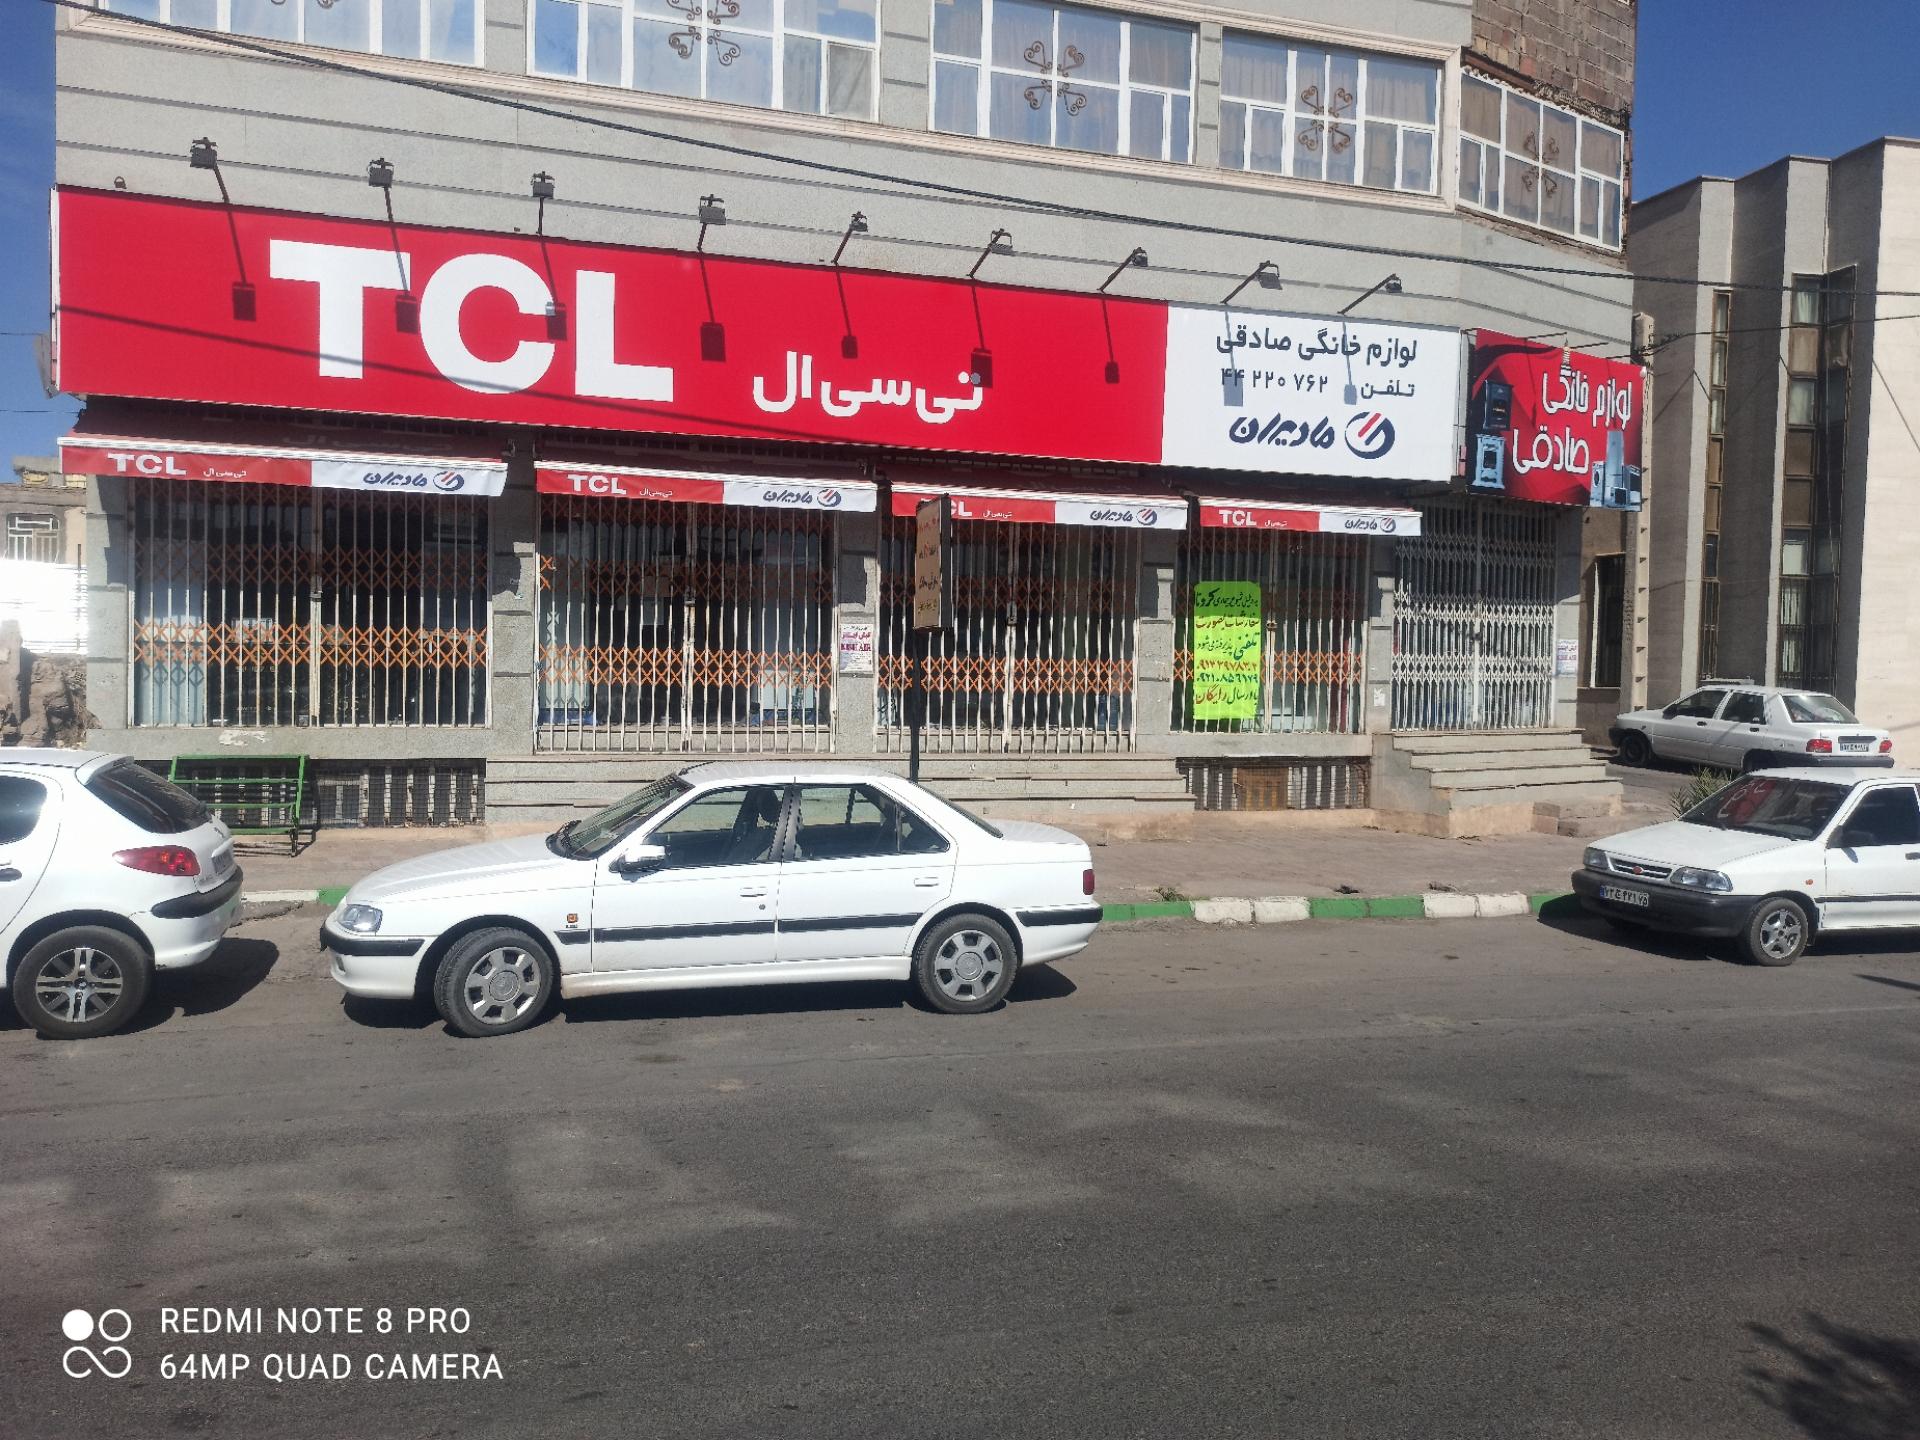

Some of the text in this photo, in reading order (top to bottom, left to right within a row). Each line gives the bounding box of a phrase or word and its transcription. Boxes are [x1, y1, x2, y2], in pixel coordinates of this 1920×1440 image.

[270, 239, 673, 402] TCL
[1216, 324, 1417, 368] لوازم خانگی صادقی
[753, 351, 983, 424] تی سی ال
[1360, 380, 1415, 399] تلفن
[1592, 378, 1632, 430] لوازم
[1229, 411, 1335, 449] مادیران
[1513, 425, 1589, 474] صادقی
[107, 453, 187, 475] TCL
[363, 471, 428, 487] مادیران
[567, 474, 627, 495] TCL
[763, 489, 813, 504] مادیران
[1090, 508, 1133, 522] مادیران
[1218, 509, 1257, 526] TCL
[1196, 587, 1221, 608] کرونا
